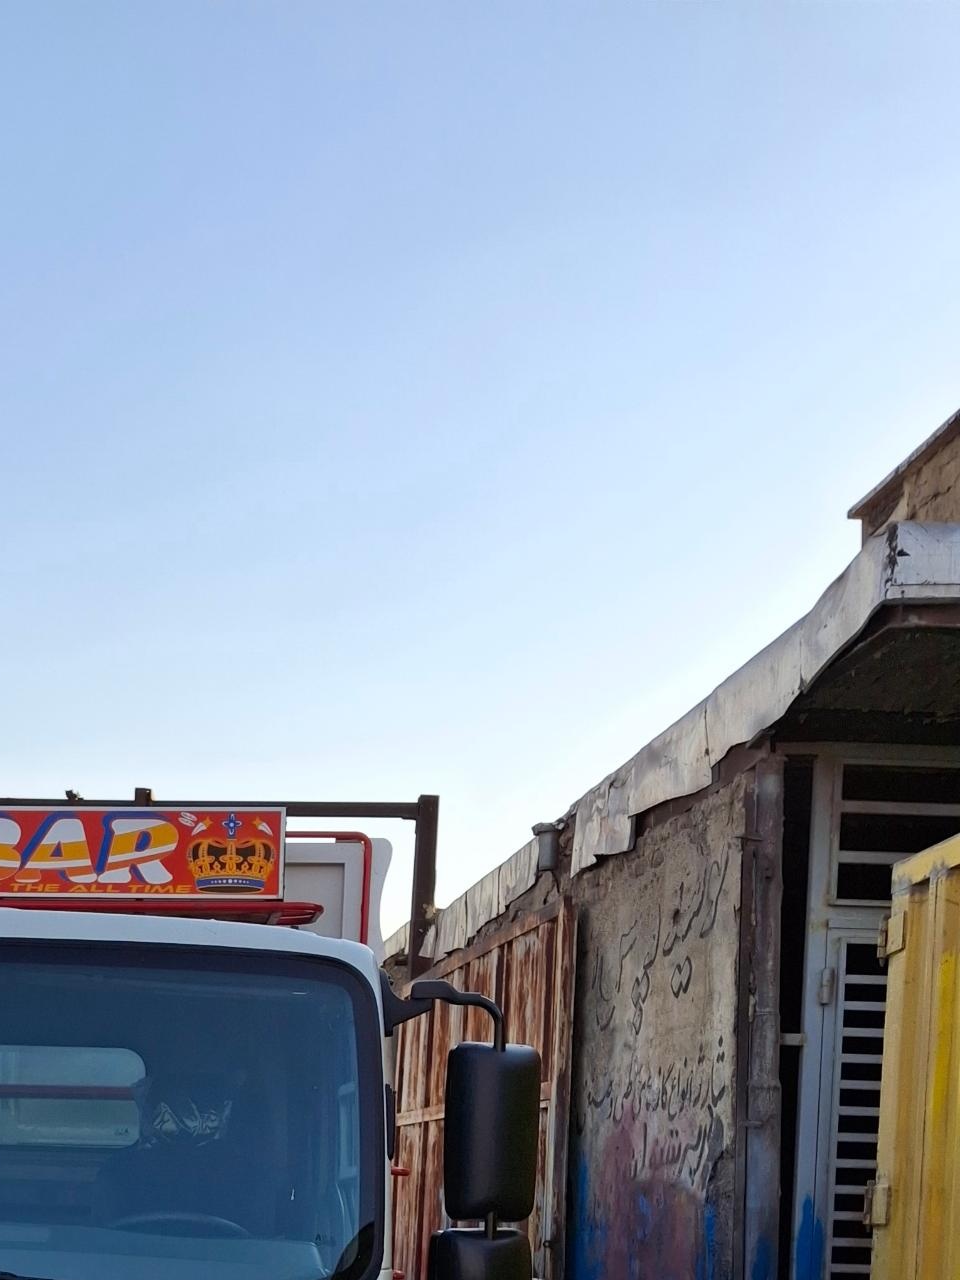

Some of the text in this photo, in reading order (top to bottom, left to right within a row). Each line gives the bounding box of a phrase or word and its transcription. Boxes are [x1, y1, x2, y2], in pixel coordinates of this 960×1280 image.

[10, 883, 60, 893] THE
[68, 884, 121, 893] ALL
[127, 884, 193, 894] TIME
